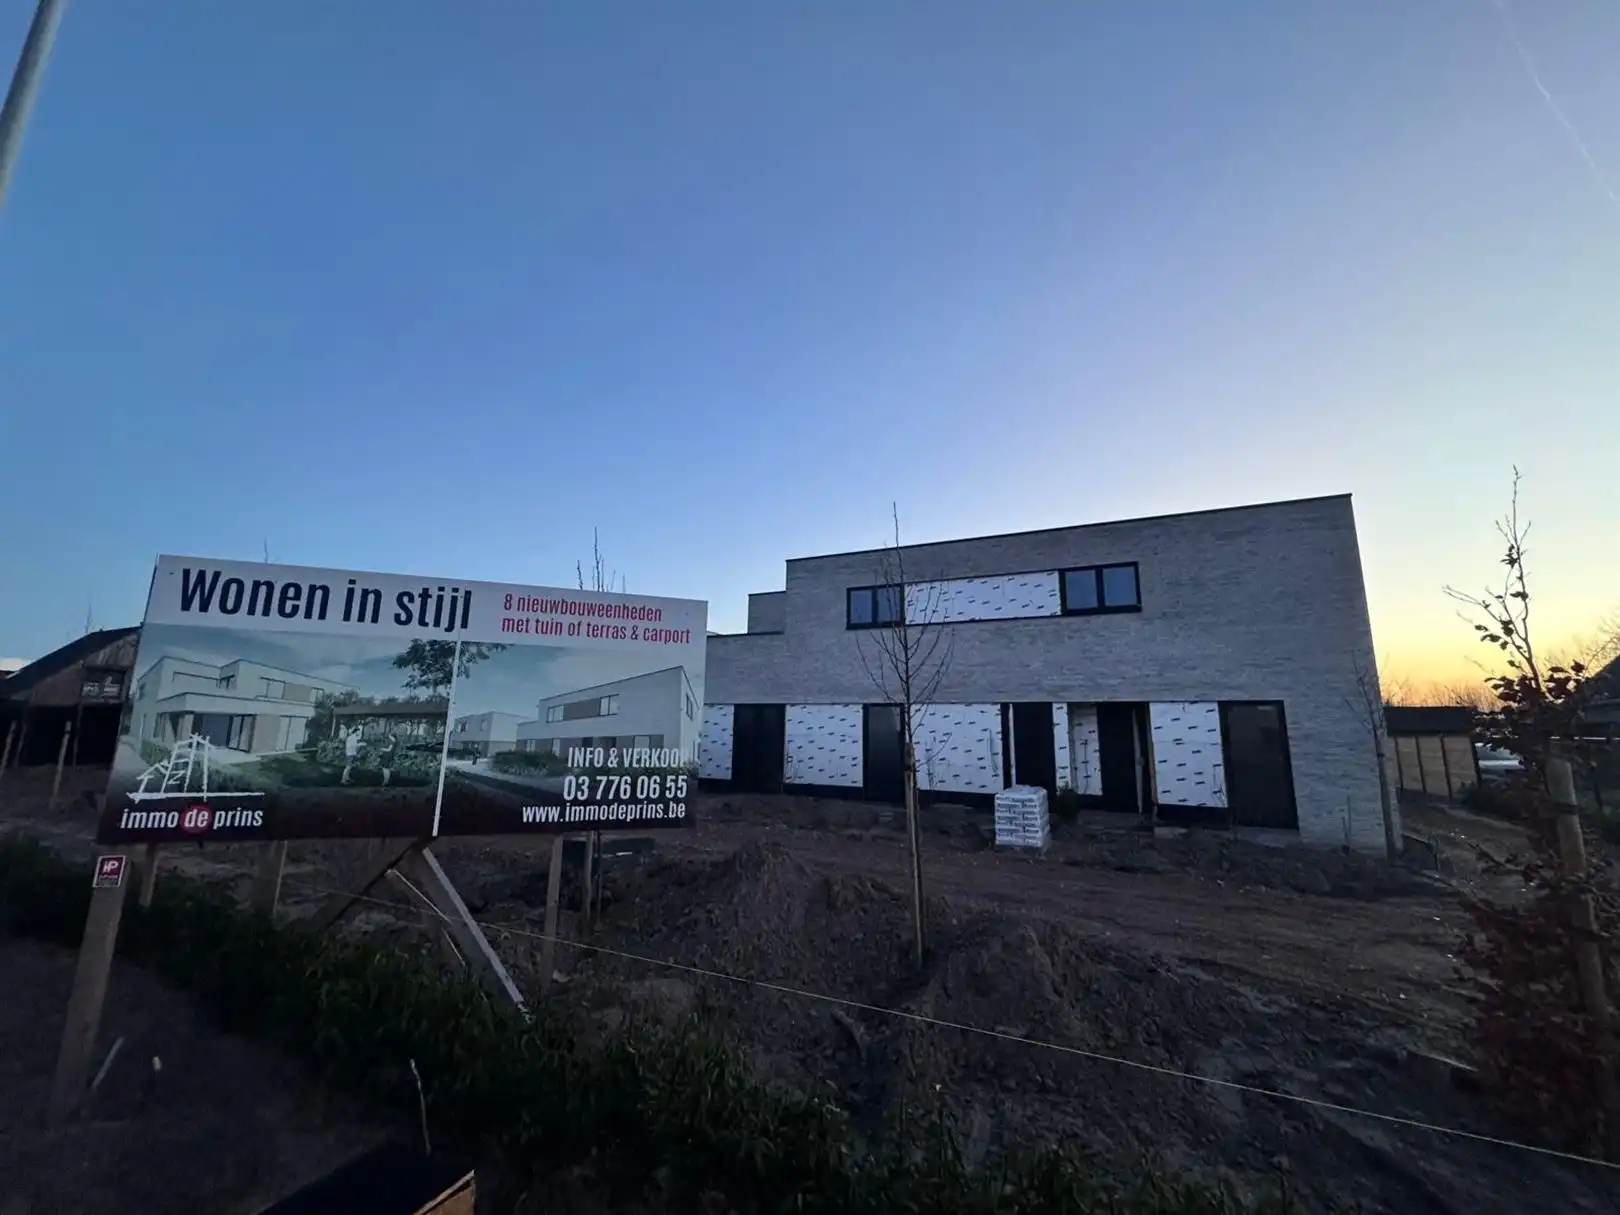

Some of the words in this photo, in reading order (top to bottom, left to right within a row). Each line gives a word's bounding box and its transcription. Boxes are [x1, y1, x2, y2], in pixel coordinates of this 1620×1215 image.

[180, 568, 330, 620] Wonen
[343, 579, 383, 624] in
[394, 586, 472, 633] stijl
[503, 593, 512, 611] 8
[516, 594, 662, 622] nieuwbouweenheden
[502, 616, 530, 633] met
[535, 617, 563, 636] tuin
[567, 620, 582, 637] of
[586, 621, 627, 640] terras
[627, 624, 639, 641] &
[643, 627, 691, 645] carport
[567, 747, 602, 768] INFO
[607, 747, 619, 768] &
[563, 775, 589, 800] 03
[596, 775, 632, 800] 776
[636, 775, 660, 799] 06
[665, 775, 688, 799] 55
[120, 808, 180, 829] immo
[184, 808, 209, 828] de
[213, 807, 264, 830] prins
[522, 801, 686, 823] www.immodeprins.be
